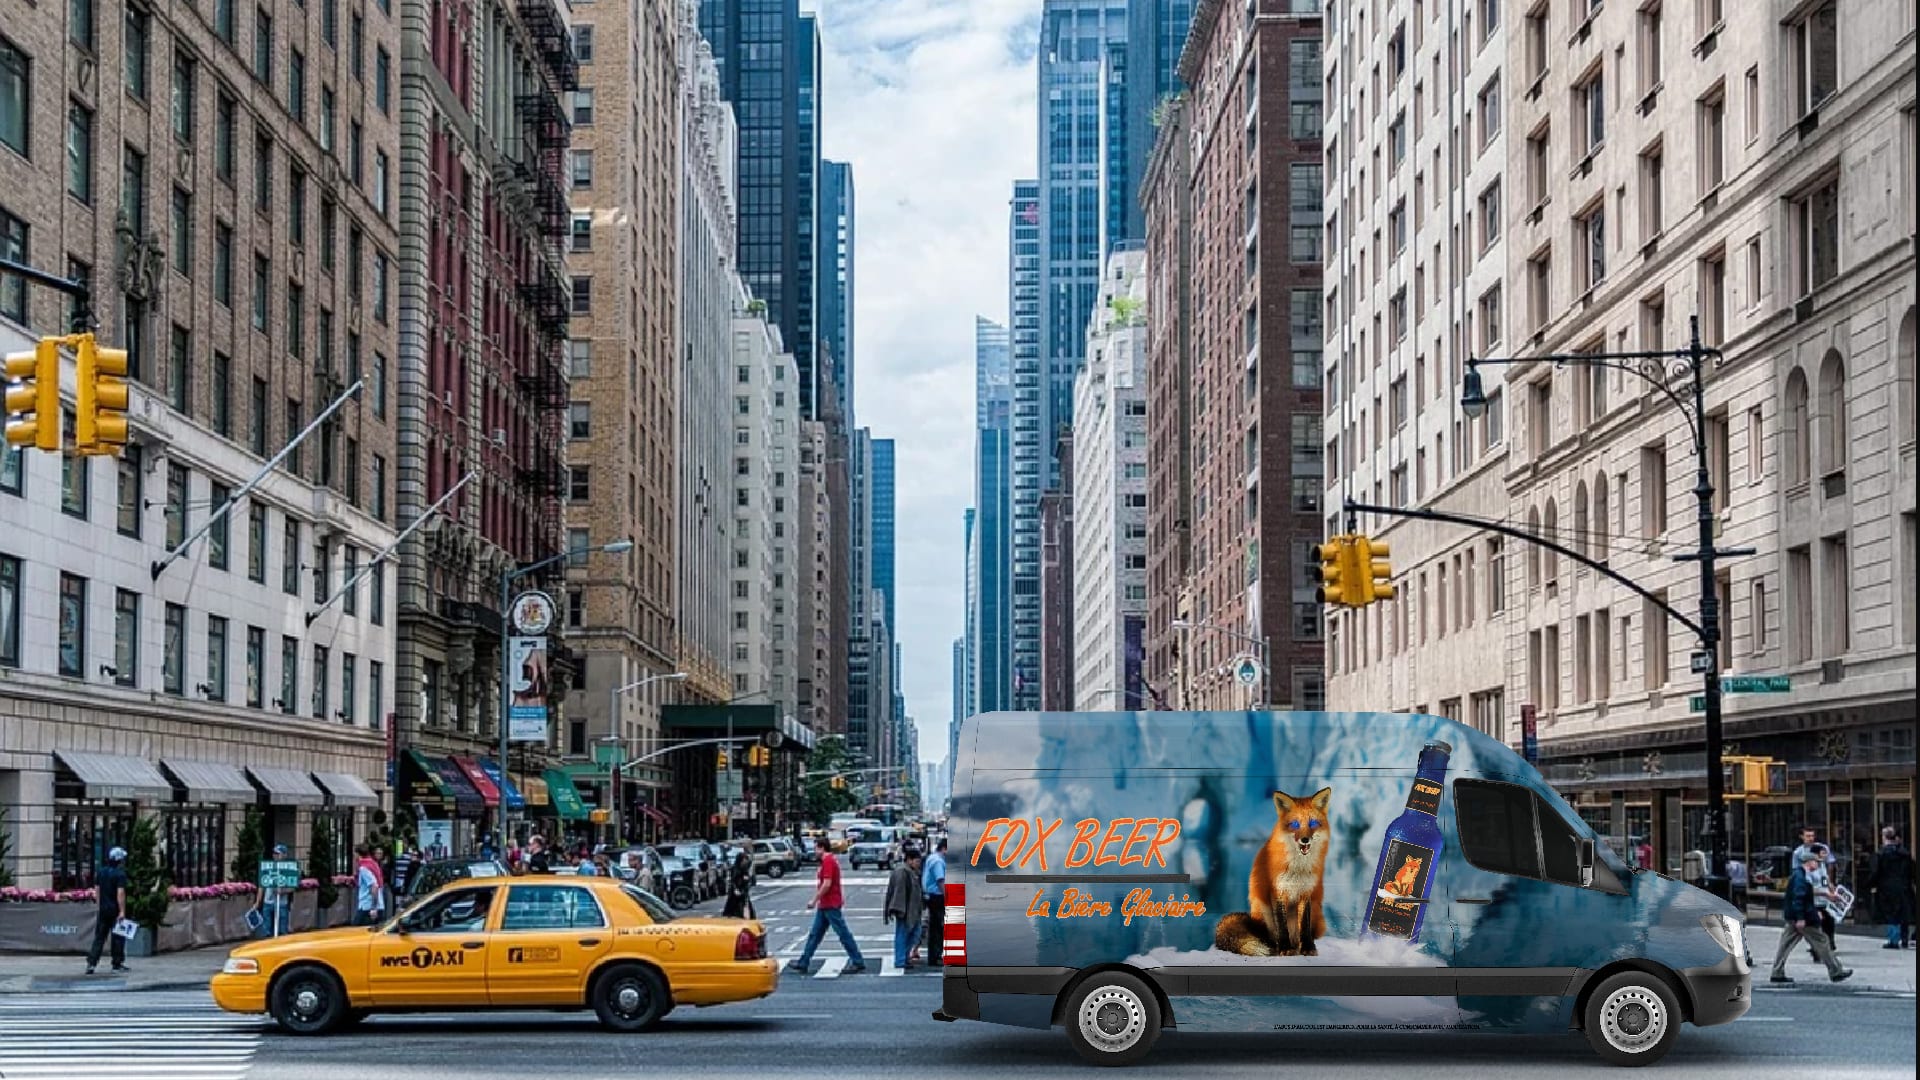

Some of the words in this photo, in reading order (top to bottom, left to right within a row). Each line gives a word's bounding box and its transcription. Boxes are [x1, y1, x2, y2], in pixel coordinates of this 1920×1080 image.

[970, 816, 1063, 872] FOX
[1064, 817, 1182, 869] BEER
[1025, 887, 1050, 918] La
[1056, 887, 1113, 919] Bière
[1120, 887, 1207, 927] Glaciaire
[379, 955, 410, 968] NYC
[411, 947, 464, 969] TAXI
